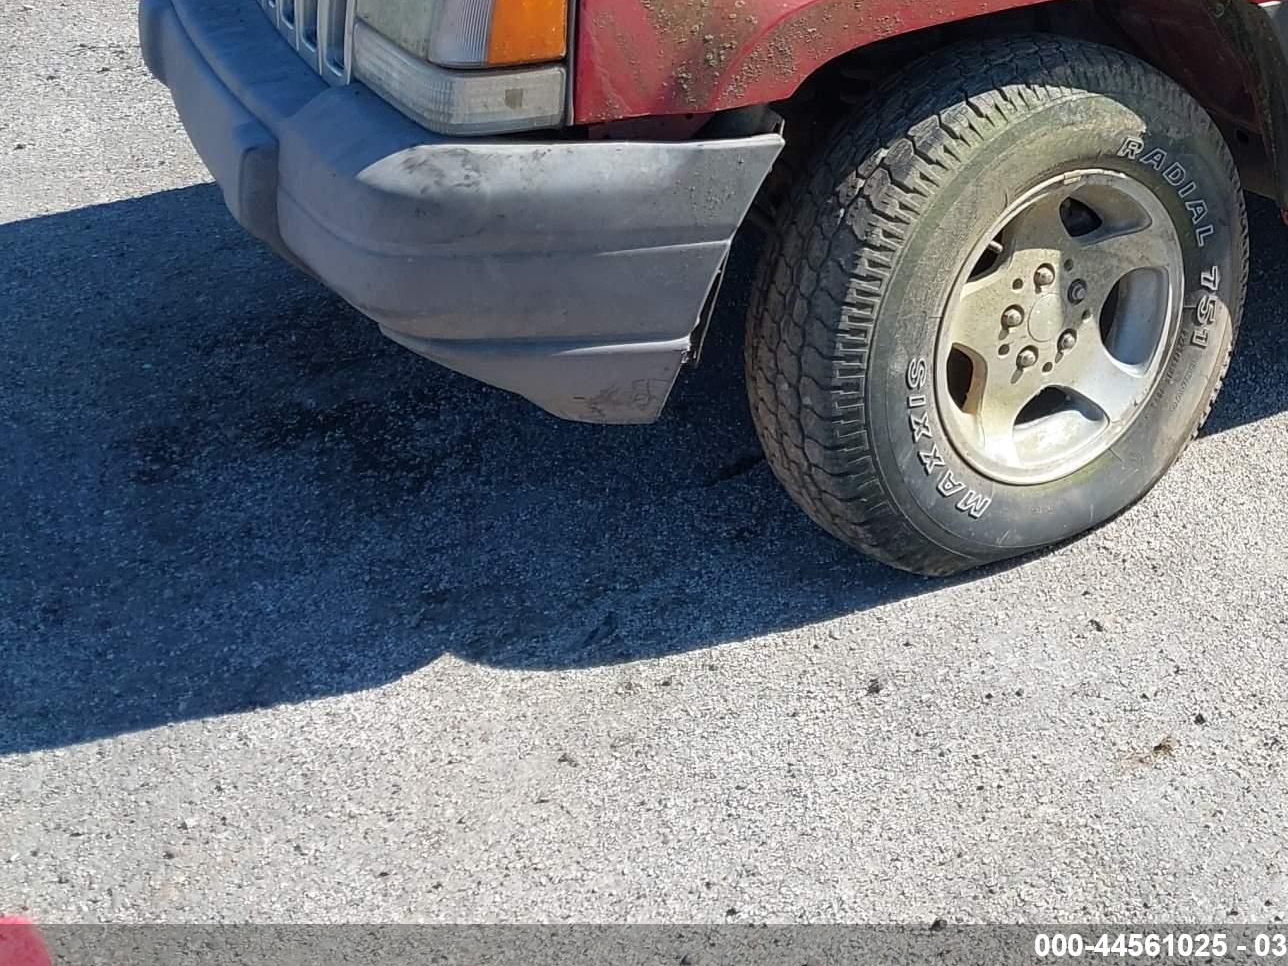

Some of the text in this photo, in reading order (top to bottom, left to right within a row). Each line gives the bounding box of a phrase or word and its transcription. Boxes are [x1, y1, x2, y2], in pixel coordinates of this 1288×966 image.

[1117, 135, 1217, 248] RADIAL
[1189, 264, 1220, 350] 751
[905, 358, 991, 519] MAXXIS
